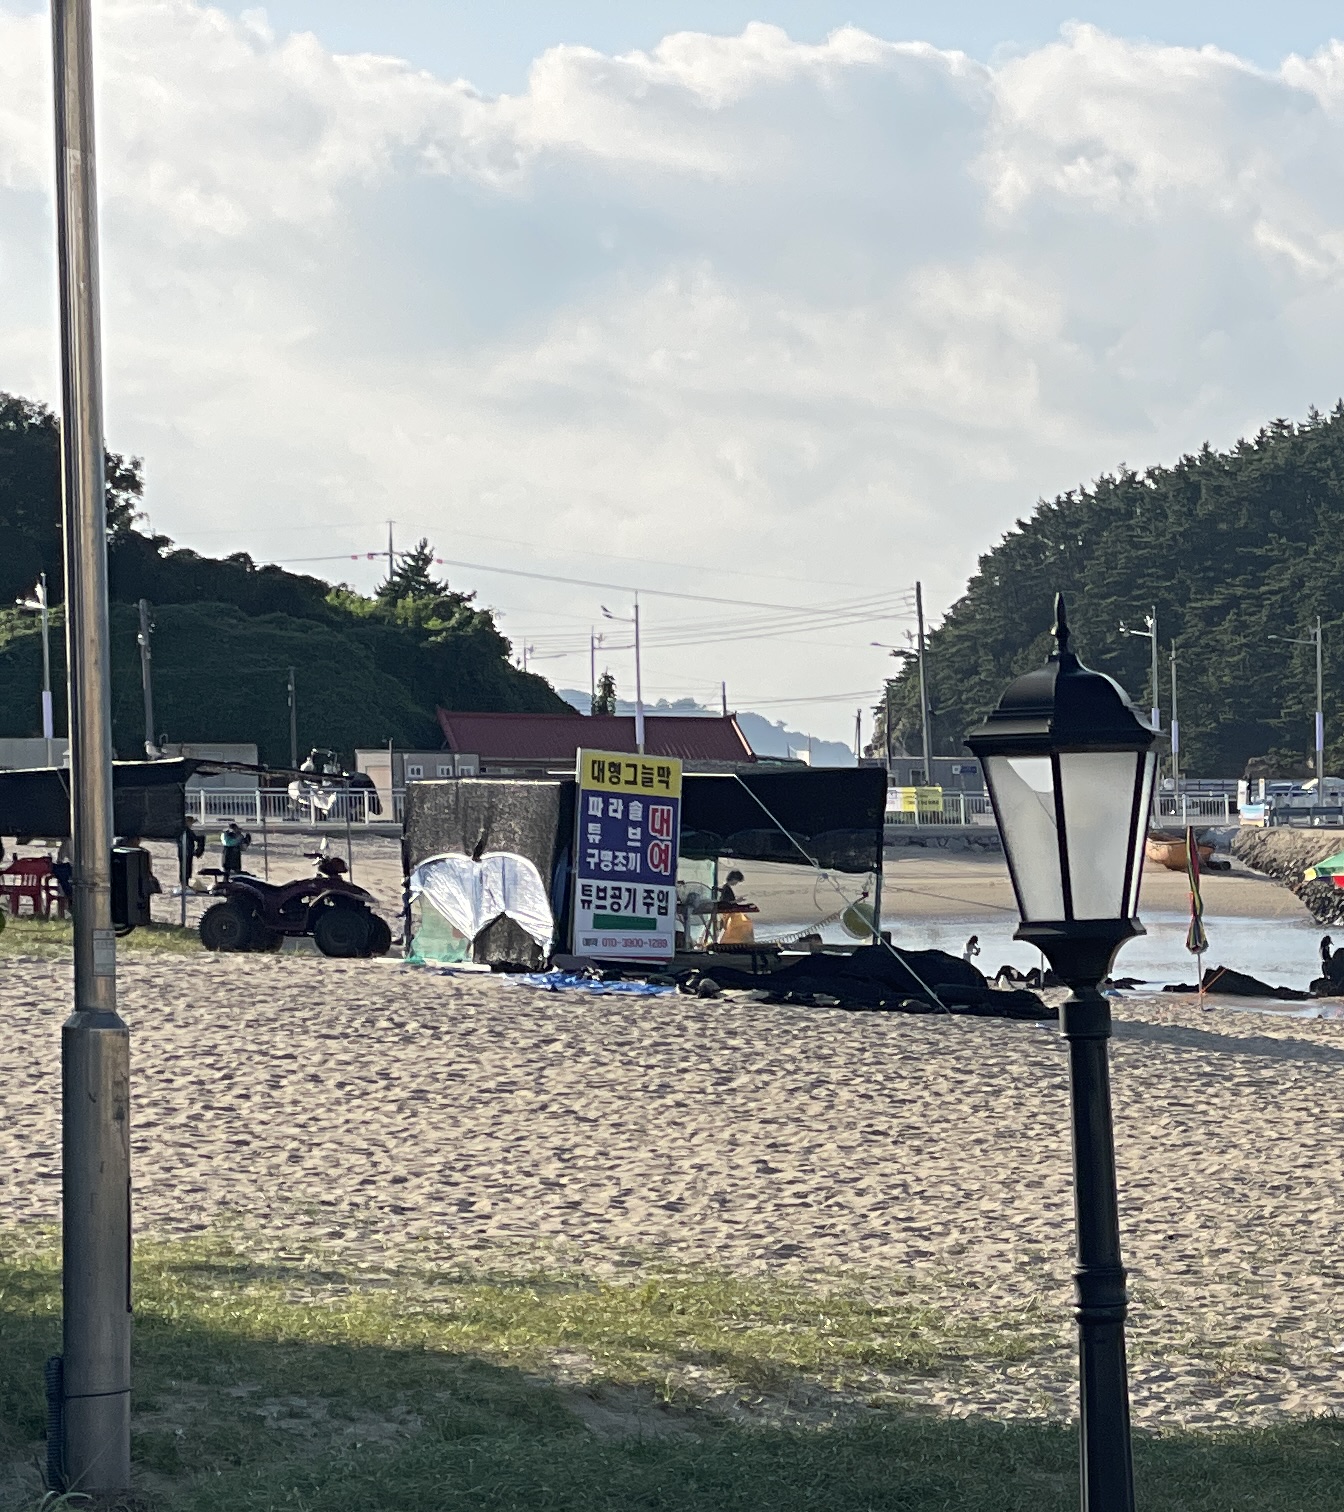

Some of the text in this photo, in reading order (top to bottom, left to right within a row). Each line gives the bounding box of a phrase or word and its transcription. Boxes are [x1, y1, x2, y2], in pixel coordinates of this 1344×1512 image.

[591, 760, 671, 789] 대형그늘막
[588, 796, 643, 821] 파라솔
[647, 804, 673, 876] 대여
[586, 848, 641, 873] 구명조끼
[580, 884, 669, 916] 튜브공기 주입
